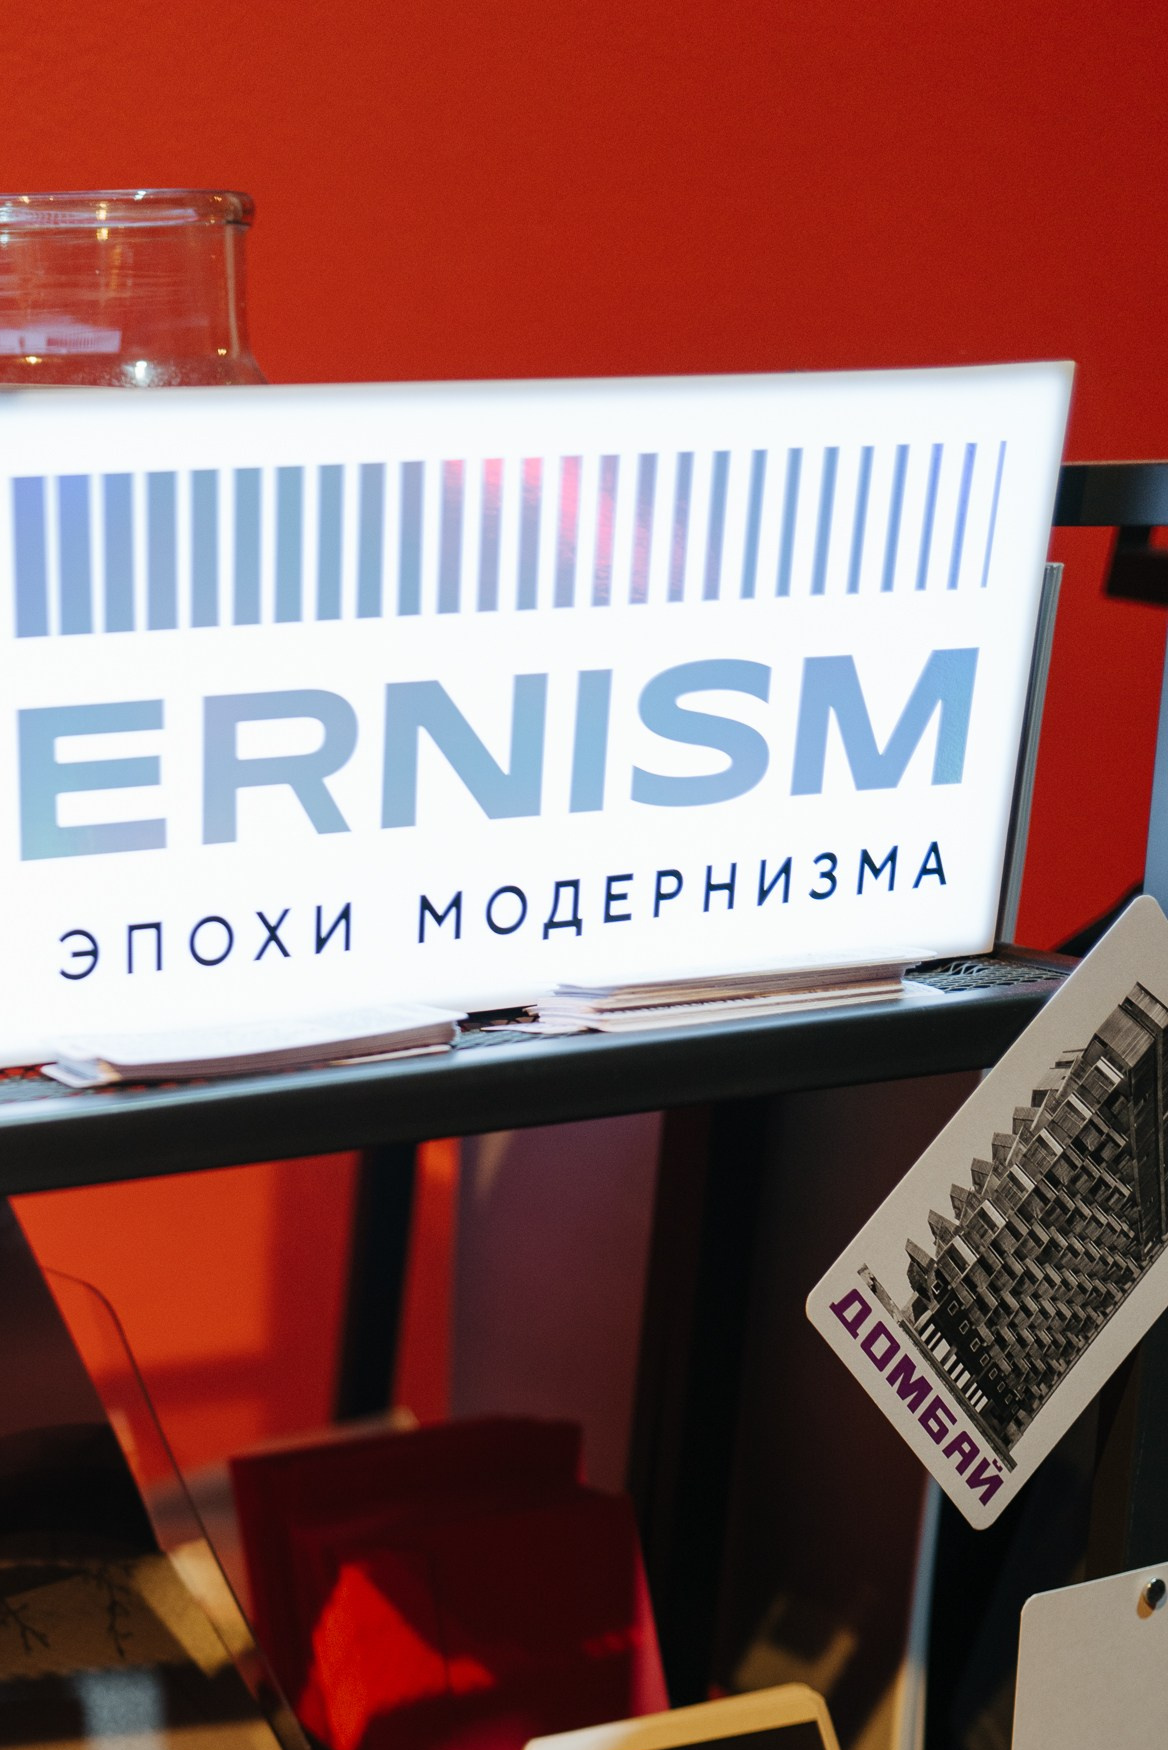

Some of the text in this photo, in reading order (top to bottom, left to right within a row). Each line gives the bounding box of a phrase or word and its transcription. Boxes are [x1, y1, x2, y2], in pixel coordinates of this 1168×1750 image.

[58, 902, 354, 982] ЭПОХИ
[417, 841, 949, 944] МОДЕРНИЗМА
[829, 1288, 1004, 1507] ДОМБАЙ
